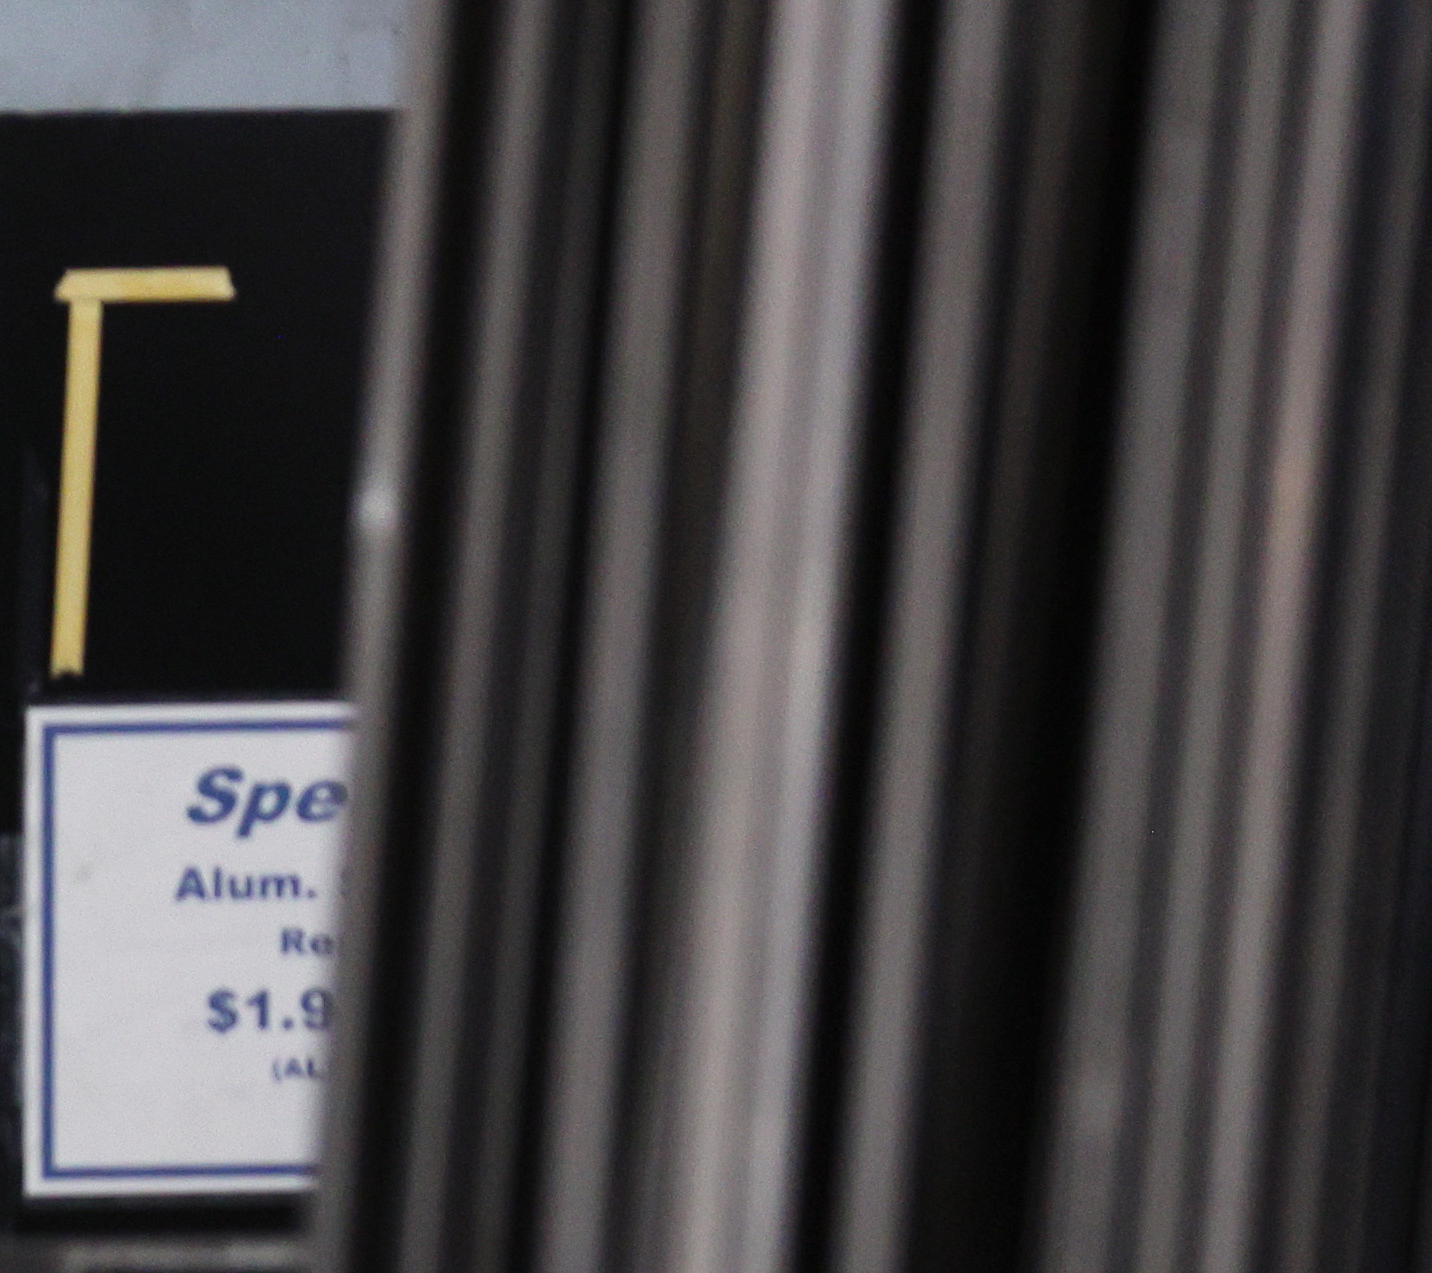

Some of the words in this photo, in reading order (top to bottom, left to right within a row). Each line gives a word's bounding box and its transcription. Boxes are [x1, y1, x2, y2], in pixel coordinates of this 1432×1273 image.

[186, 766, 349, 839] Spe
[176, 866, 318, 901] Alum.
[280, 927, 334, 955] Re
[206, 986, 332, 1034] $1.9
